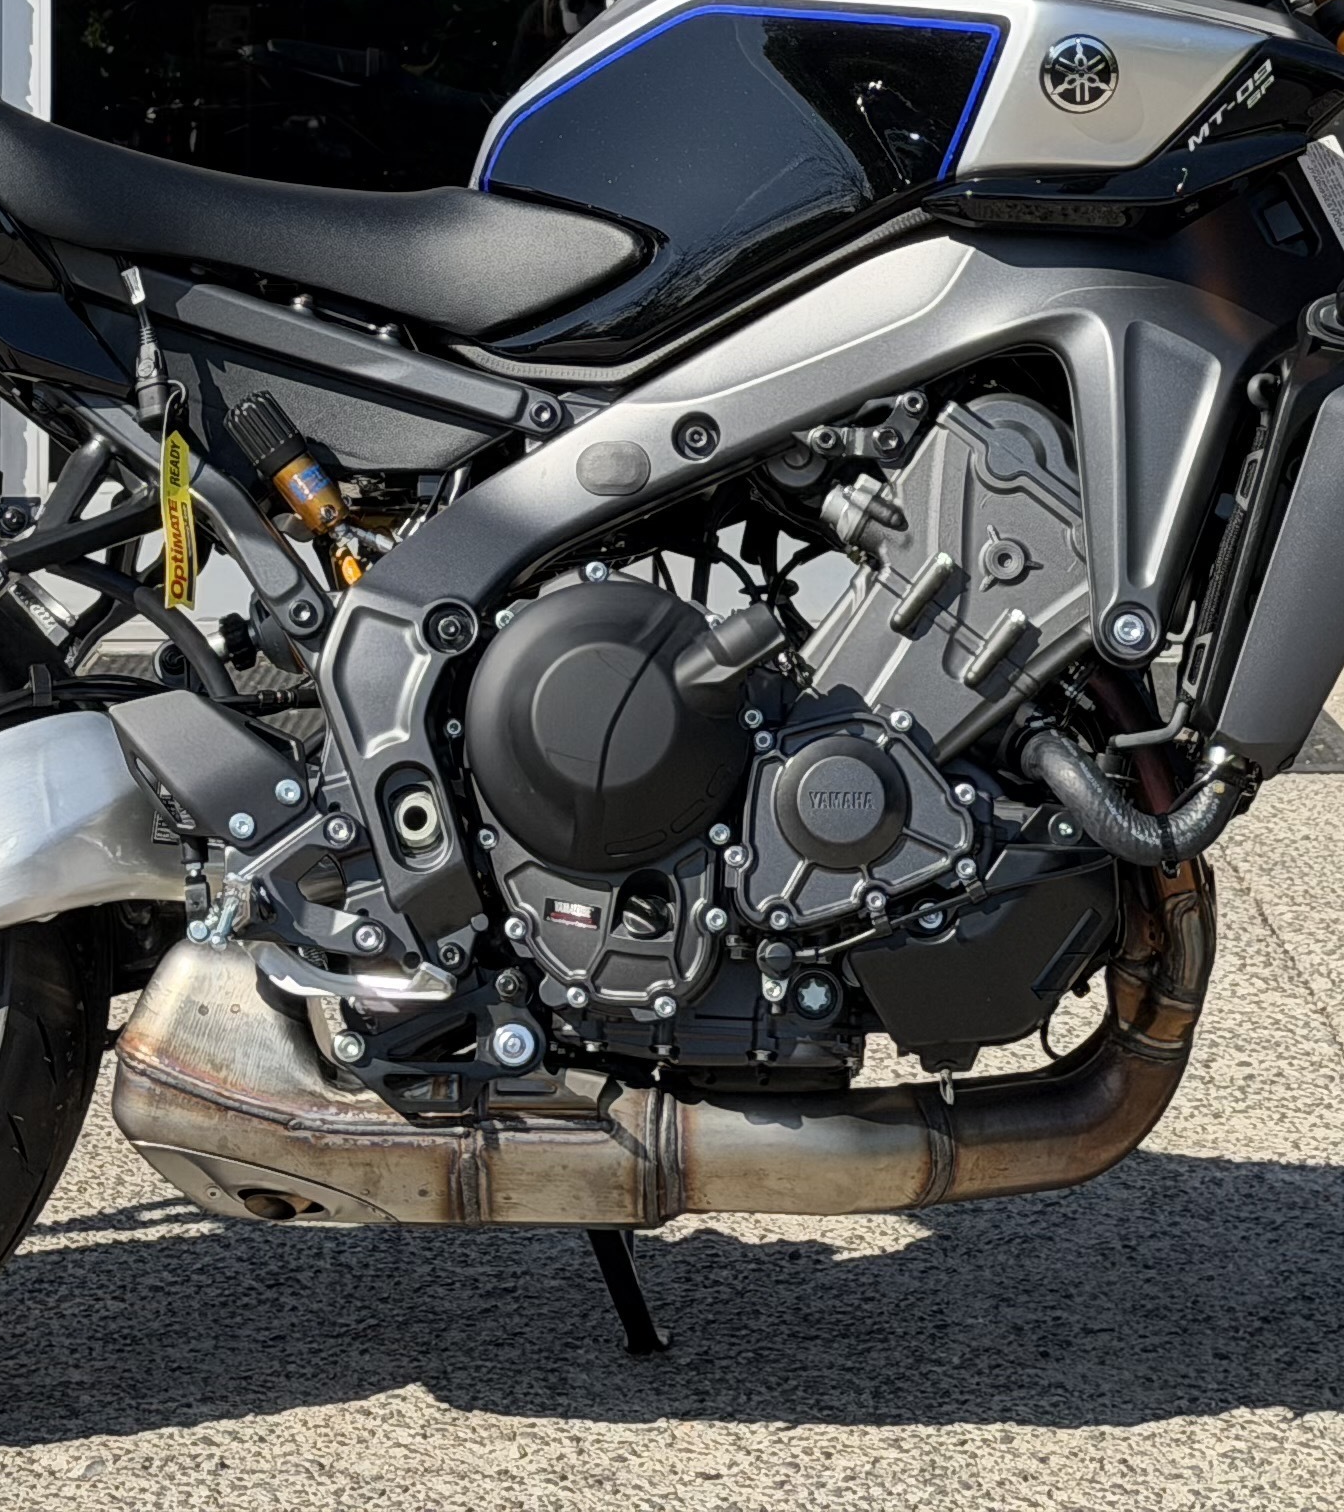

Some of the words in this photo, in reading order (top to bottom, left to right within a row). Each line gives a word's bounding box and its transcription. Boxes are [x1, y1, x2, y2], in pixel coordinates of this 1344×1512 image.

[1187, 58, 1273, 153] MT-09
[169, 440, 182, 488] READY
[808, 790, 875, 810] YAMAHA
